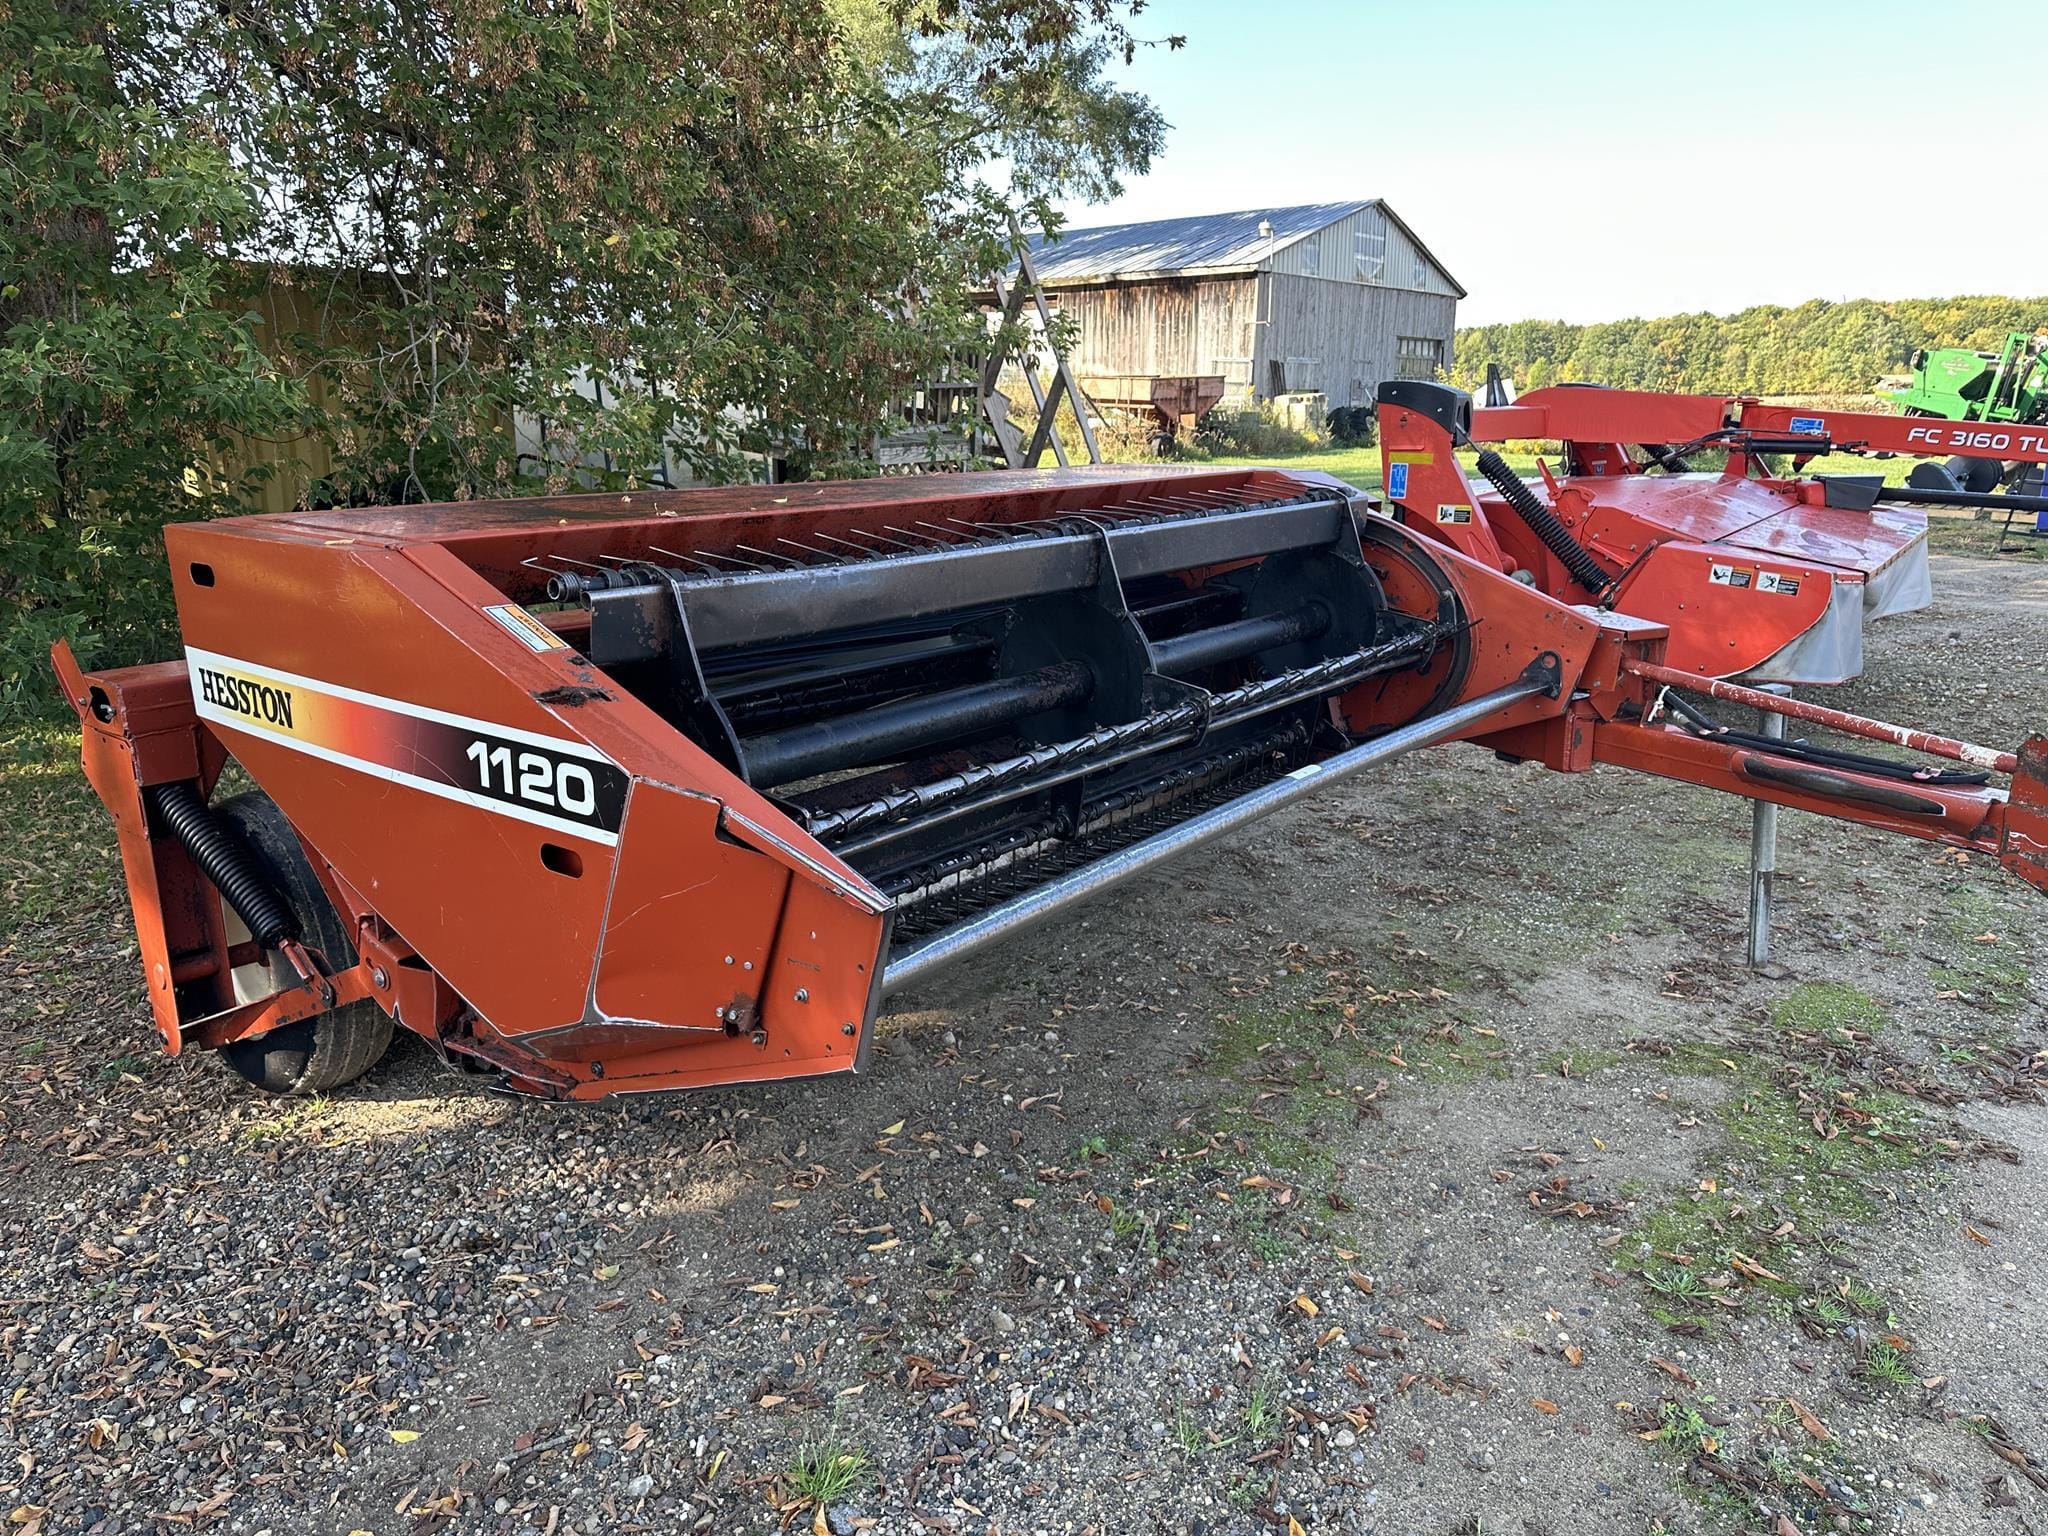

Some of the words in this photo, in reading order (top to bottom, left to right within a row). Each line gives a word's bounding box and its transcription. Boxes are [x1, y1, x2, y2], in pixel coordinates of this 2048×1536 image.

[1907, 428, 1943, 445] FC
[1948, 430, 2010, 450] 3160
[198, 667, 294, 729] HESSTON
[466, 740, 595, 816] 1120
